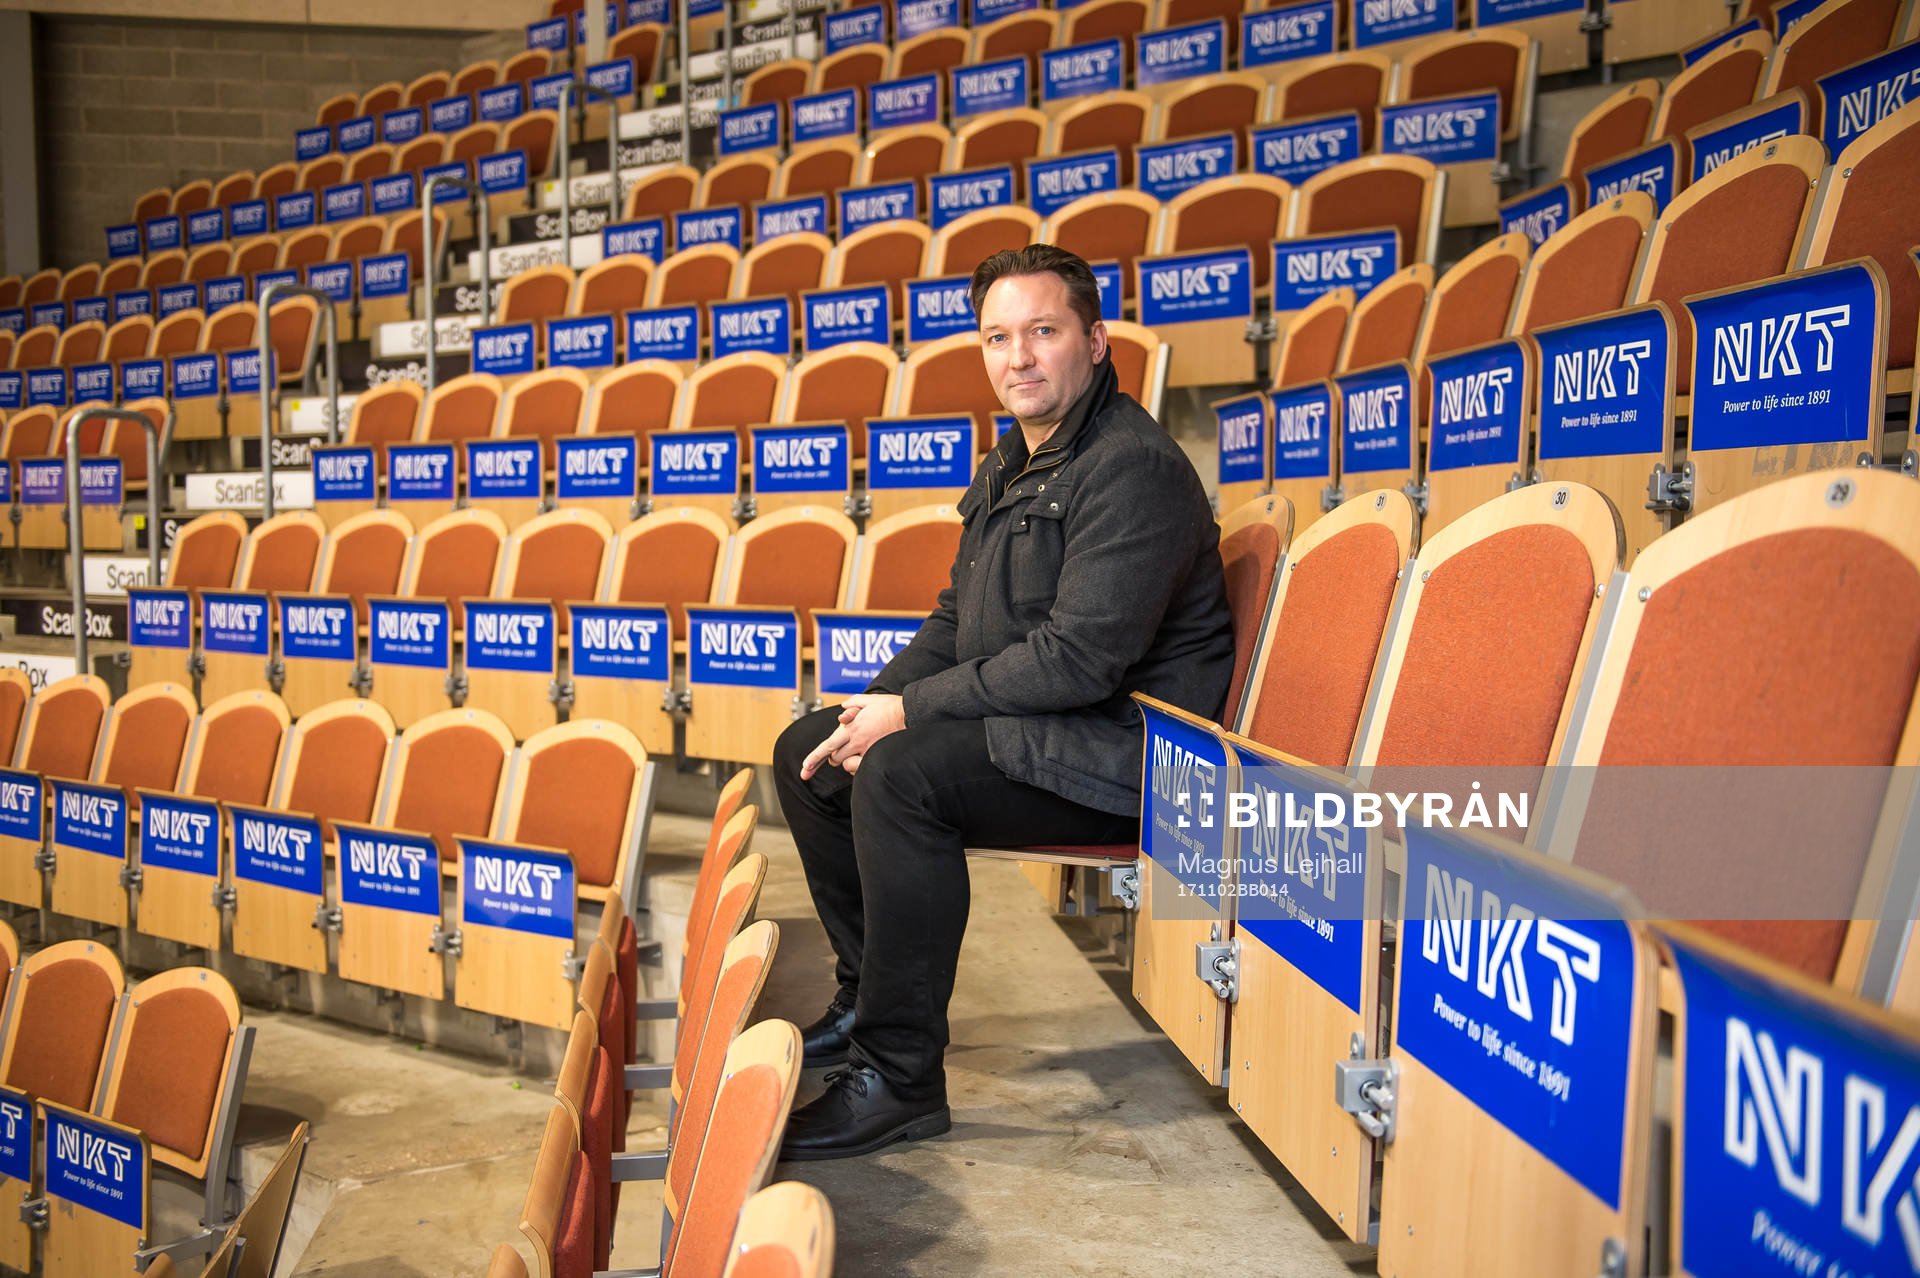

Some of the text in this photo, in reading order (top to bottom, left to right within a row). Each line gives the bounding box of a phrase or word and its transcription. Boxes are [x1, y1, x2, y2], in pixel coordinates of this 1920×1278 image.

[1252, 11, 1325, 46] NKT
[1051, 49, 1114, 80] NKT
[1147, 32, 1215, 65] NKT
[878, 84, 932, 111] NKT
[960, 68, 1019, 96] NKT
[725, 112, 774, 138] NKT
[799, 99, 851, 124] NKT
[1395, 108, 1486, 144] NKT
[1264, 128, 1347, 166] NKT
[1038, 163, 1108, 195] NKT
[1149, 148, 1225, 181] NKT
[848, 194, 907, 221] NKT
[940, 179, 1005, 207] NKT
[610, 229, 657, 252] NKT
[684, 217, 735, 240] NKT
[1288, 246, 1382, 282] NKT
[1151, 262, 1238, 300] NKT
[721, 309, 782, 337] NKT
[815, 298, 880, 328] NKT
[555, 325, 608, 351] NKT
[634, 317, 691, 342] NKT
[1713, 304, 1850, 385] NKT
[480, 333, 529, 359] NKT
[1554, 339, 1651, 405] NKT
[1349, 385, 1402, 433] NKT
[1440, 366, 1512, 424] NKT
[1723, 389, 1831, 413] Power to life since 1891
[1223, 413, 1260, 452] NKT
[1279, 401, 1325, 443] NKT
[1561, 409, 1637, 428] Power to life since 1891
[567, 448, 629, 475] NKT
[661, 443, 728, 470] NKT
[763, 437, 838, 468] NKT
[879, 431, 961, 463] NKT
[320, 456, 369, 480] NKT
[396, 455, 449, 479] NKT
[476, 451, 533, 476] NKT
[215, 478, 285, 503] ScanBx
[1554, 491, 1567, 505] 30
[136, 600, 184, 625] NKT
[211, 603, 263, 630] NKT
[288, 607, 345, 635] NKT
[378, 610, 440, 641] NKT
[474, 613, 545, 645] NKT
[582, 618, 658, 651] NKT
[701, 622, 785, 657] NKT
[1152, 734, 1216, 824] NKT
[63, 791, 118, 827] NKT
[151, 808, 211, 844] NKT
[244, 820, 311, 861] NKT
[1155, 813, 1168, 831] Power
[1168, 824, 1174, 836] to
[1181, 831, 1193, 850] since
[1252, 781, 1349, 902] NKT
[350, 840, 427, 880] NKT
[475, 856, 561, 900] NKT
[1279, 894, 1286, 910] to
[1287, 895, 1298, 919] life
[1298, 905, 1315, 930] since
[1316, 917, 1334, 943] 1891
[1422, 863, 1600, 1046] NKT
[1433, 993, 1570, 1102] Power to life since 1891
[57, 1123, 131, 1182] NKT
[1724, 1016, 1920, 1278] NK
[63, 1170, 123, 1200] Power to life since 1891
